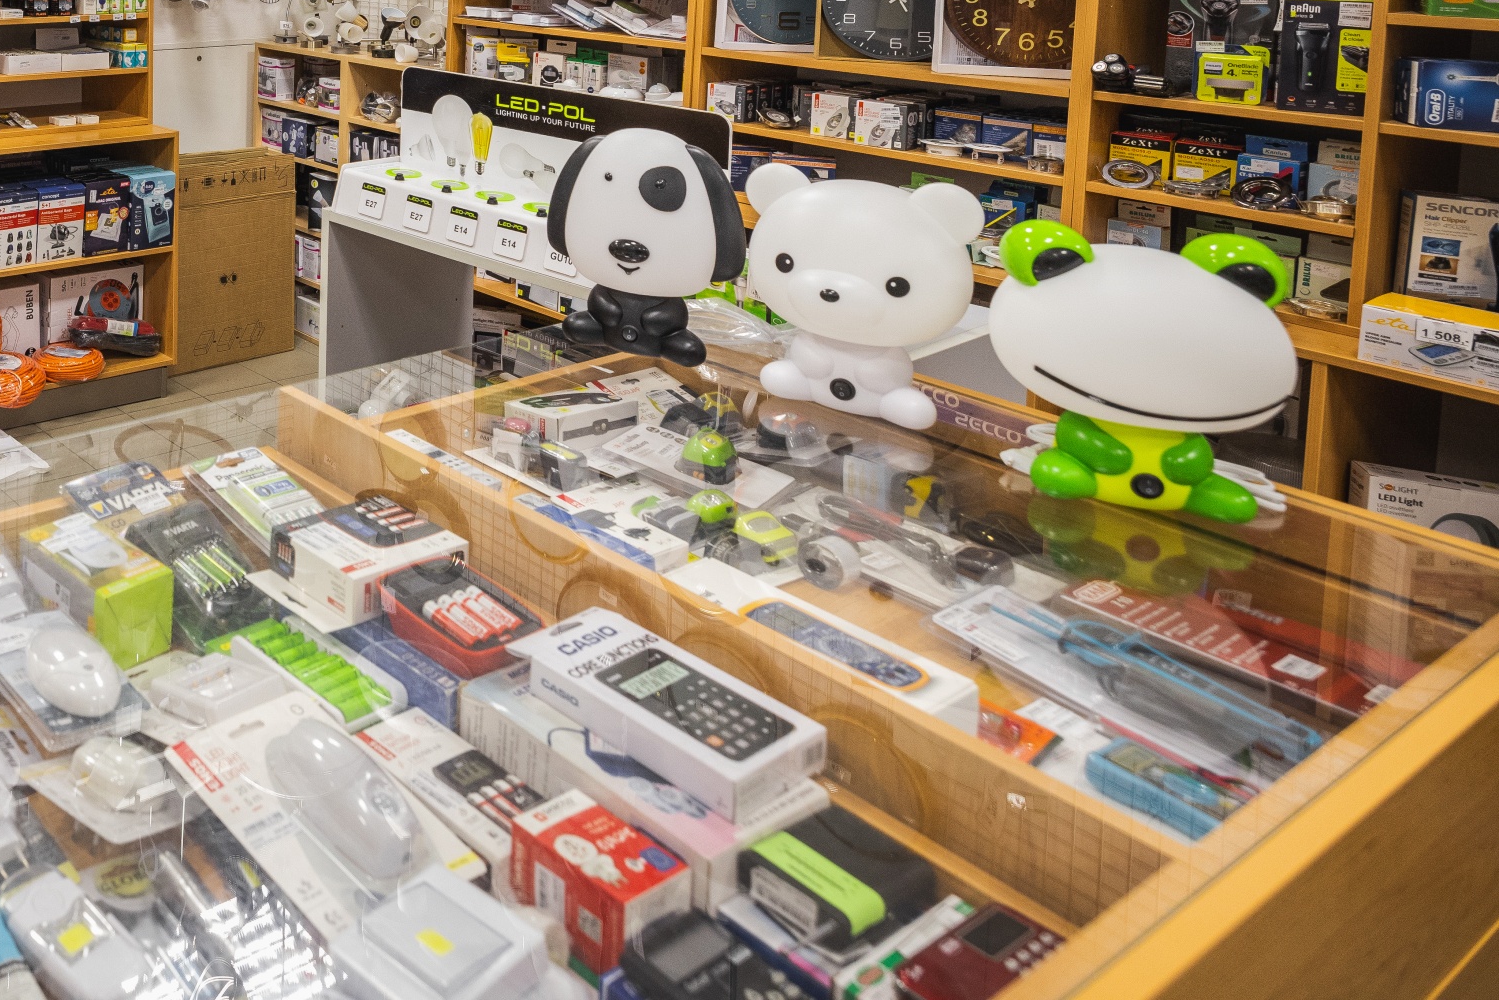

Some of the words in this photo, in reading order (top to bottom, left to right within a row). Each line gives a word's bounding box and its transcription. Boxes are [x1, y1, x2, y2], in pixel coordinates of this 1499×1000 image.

[1289, 3, 1321, 14] BRAUN
[843, 13, 857, 25] 8
[971, 8, 988, 27] 8
[863, 30, 877, 42] 7
[889, 37, 903, 50] 6
[917, 31, 932, 43] 5
[994, 27, 1011, 46] 7
[1018, 32, 1035, 51] 6
[1046, 29, 1064, 48] 5
[1227, 62, 1259, 70] OneBlade
[1429, 92, 1441, 122] Oral-B
[1446, 95, 1455, 120] VITALITY
[495, 108, 528, 120] LIGHTING
[529, 114, 540, 122] UP
[542, 116, 562, 127] YOUR
[564, 120, 596, 133] FUTURE
[1122, 136, 1154, 148] ZeXt
[1188, 145, 1223, 157] ZeXt
[1334, 152, 1360, 161] BRILU
[365, 199, 378, 209] E27
[1425, 201, 1499, 219] SENCOR
[409, 211, 423, 222] E27
[1129, 210, 1156, 218] BRILUM
[1424, 213, 1441, 221] Hair
[1441, 216, 1468, 225] Clipper
[453, 224, 468, 235] E14
[501, 238, 517, 249] E14
[1302, 261, 1311, 287] BRILUX
[26, 289, 34, 320] BUBEN
[1367, 317, 1416, 335] eta
[1421, 328, 1429, 338] 1
[1434, 330, 1470, 347] 508,-
[215, 462, 266, 482] Panasonic
[105, 480, 171, 512] VARTA
[1378, 492, 1397, 502] LED
[1397, 495, 1424, 508] Light
[169, 521, 199, 537] VARTA
[557, 625, 618, 657] CASIO
[567, 659, 598, 679] CORE
[597, 633, 660, 667] NCTIONS
